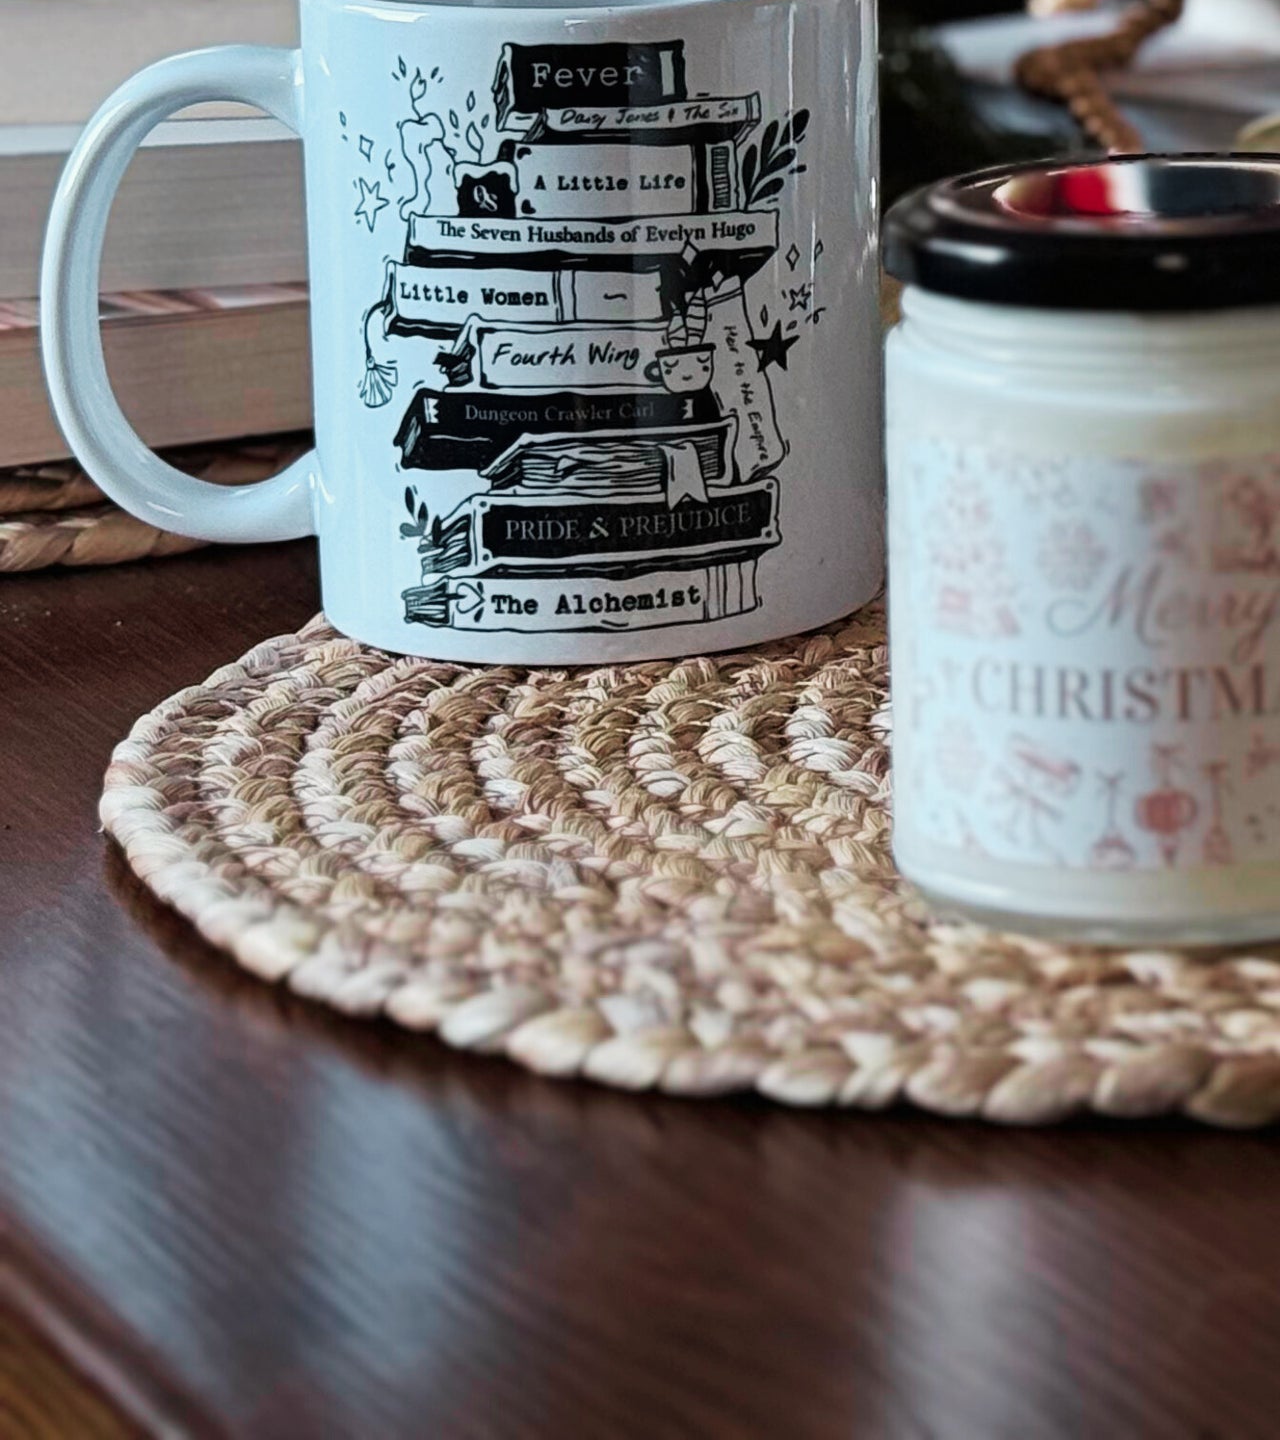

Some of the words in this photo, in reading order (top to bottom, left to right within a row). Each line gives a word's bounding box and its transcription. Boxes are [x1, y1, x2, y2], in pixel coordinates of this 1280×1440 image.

[531, 62, 645, 89] Fever
[560, 108, 606, 129] Daisy
[616, 108, 660, 125] Jones
[684, 103, 711, 120] The
[534, 173, 547, 192] A
[557, 175, 629, 192] Little
[639, 173, 686, 190] Life
[437, 219, 468, 240] The
[470, 223, 522, 243] Seven
[527, 225, 616, 244] Husbands
[621, 225, 640, 244] of
[645, 223, 707, 247] Evelyn
[711, 221, 756, 247] Hugo
[399, 281, 468, 305] Little
[481, 287, 550, 307] Women
[491, 342, 576, 367] Fourth
[587, 342, 641, 370] Wing
[464, 403, 540, 423] Dungeon
[544, 404, 615, 423] Crawler
[619, 401, 656, 419] Carl
[734, 361, 745, 376] to
[740, 382, 754, 406] the
[748, 410, 769, 460] Empire
[504, 514, 580, 542] PRIDE
[588, 515, 611, 538] &
[620, 500, 751, 538] PREJUDICE
[491, 593, 539, 616] The
[554, 585, 702, 616] Alchemist
